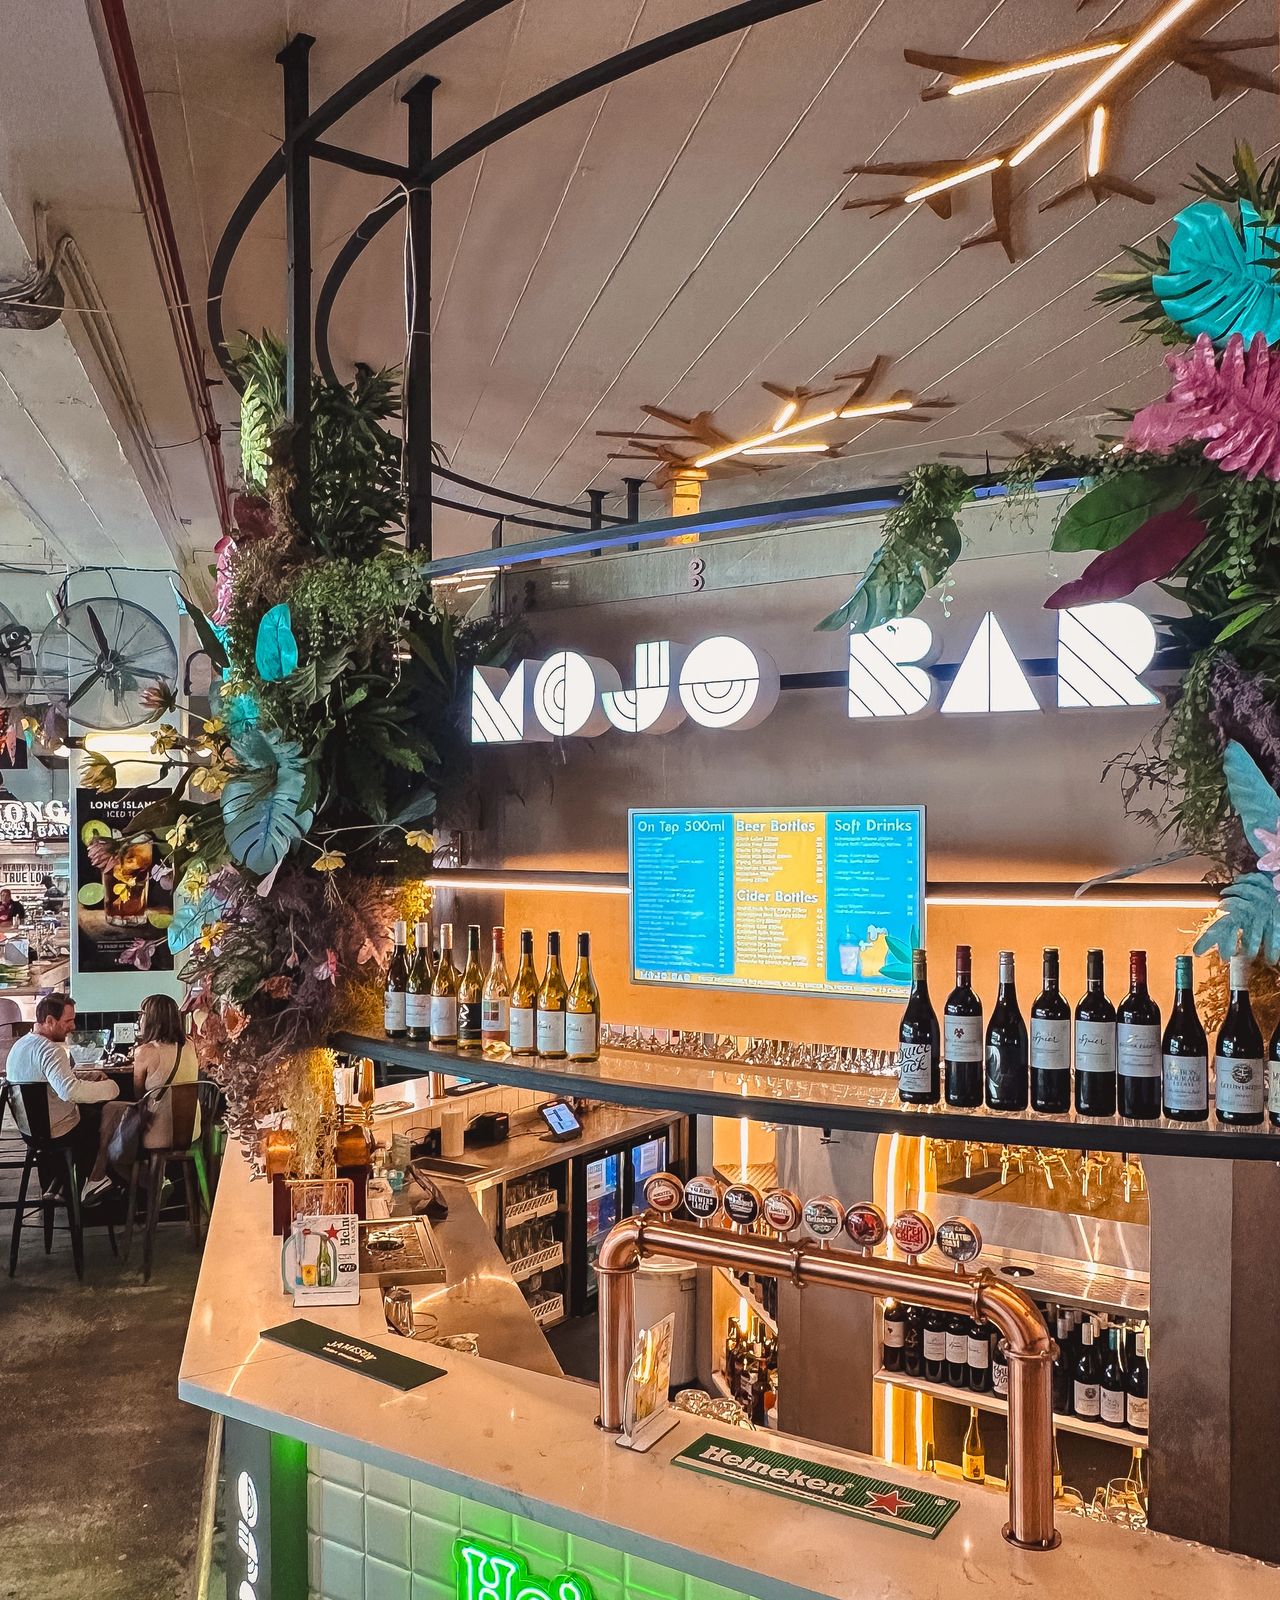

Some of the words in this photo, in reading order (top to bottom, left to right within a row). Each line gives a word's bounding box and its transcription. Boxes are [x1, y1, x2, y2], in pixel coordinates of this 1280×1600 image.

[471, 635, 760, 743] MOJO
[848, 602, 1161, 718] BAR
[90, 801, 119, 809] LONG
[122, 800, 157, 809] ISLAN
[638, 821, 655, 832] On
[659, 821, 679, 835] Tap
[684, 819, 725, 832] 500ml
[736, 820, 767, 832] Beer
[771, 819, 816, 832] Bottles
[835, 819, 861, 834] Soft
[866, 818, 912, 832] Drinks
[3, 872, 27, 883] TRUE
[736, 889, 770, 901] Cider
[775, 891, 818, 903] Bottles
[698, 1445, 850, 1497] Heineken
